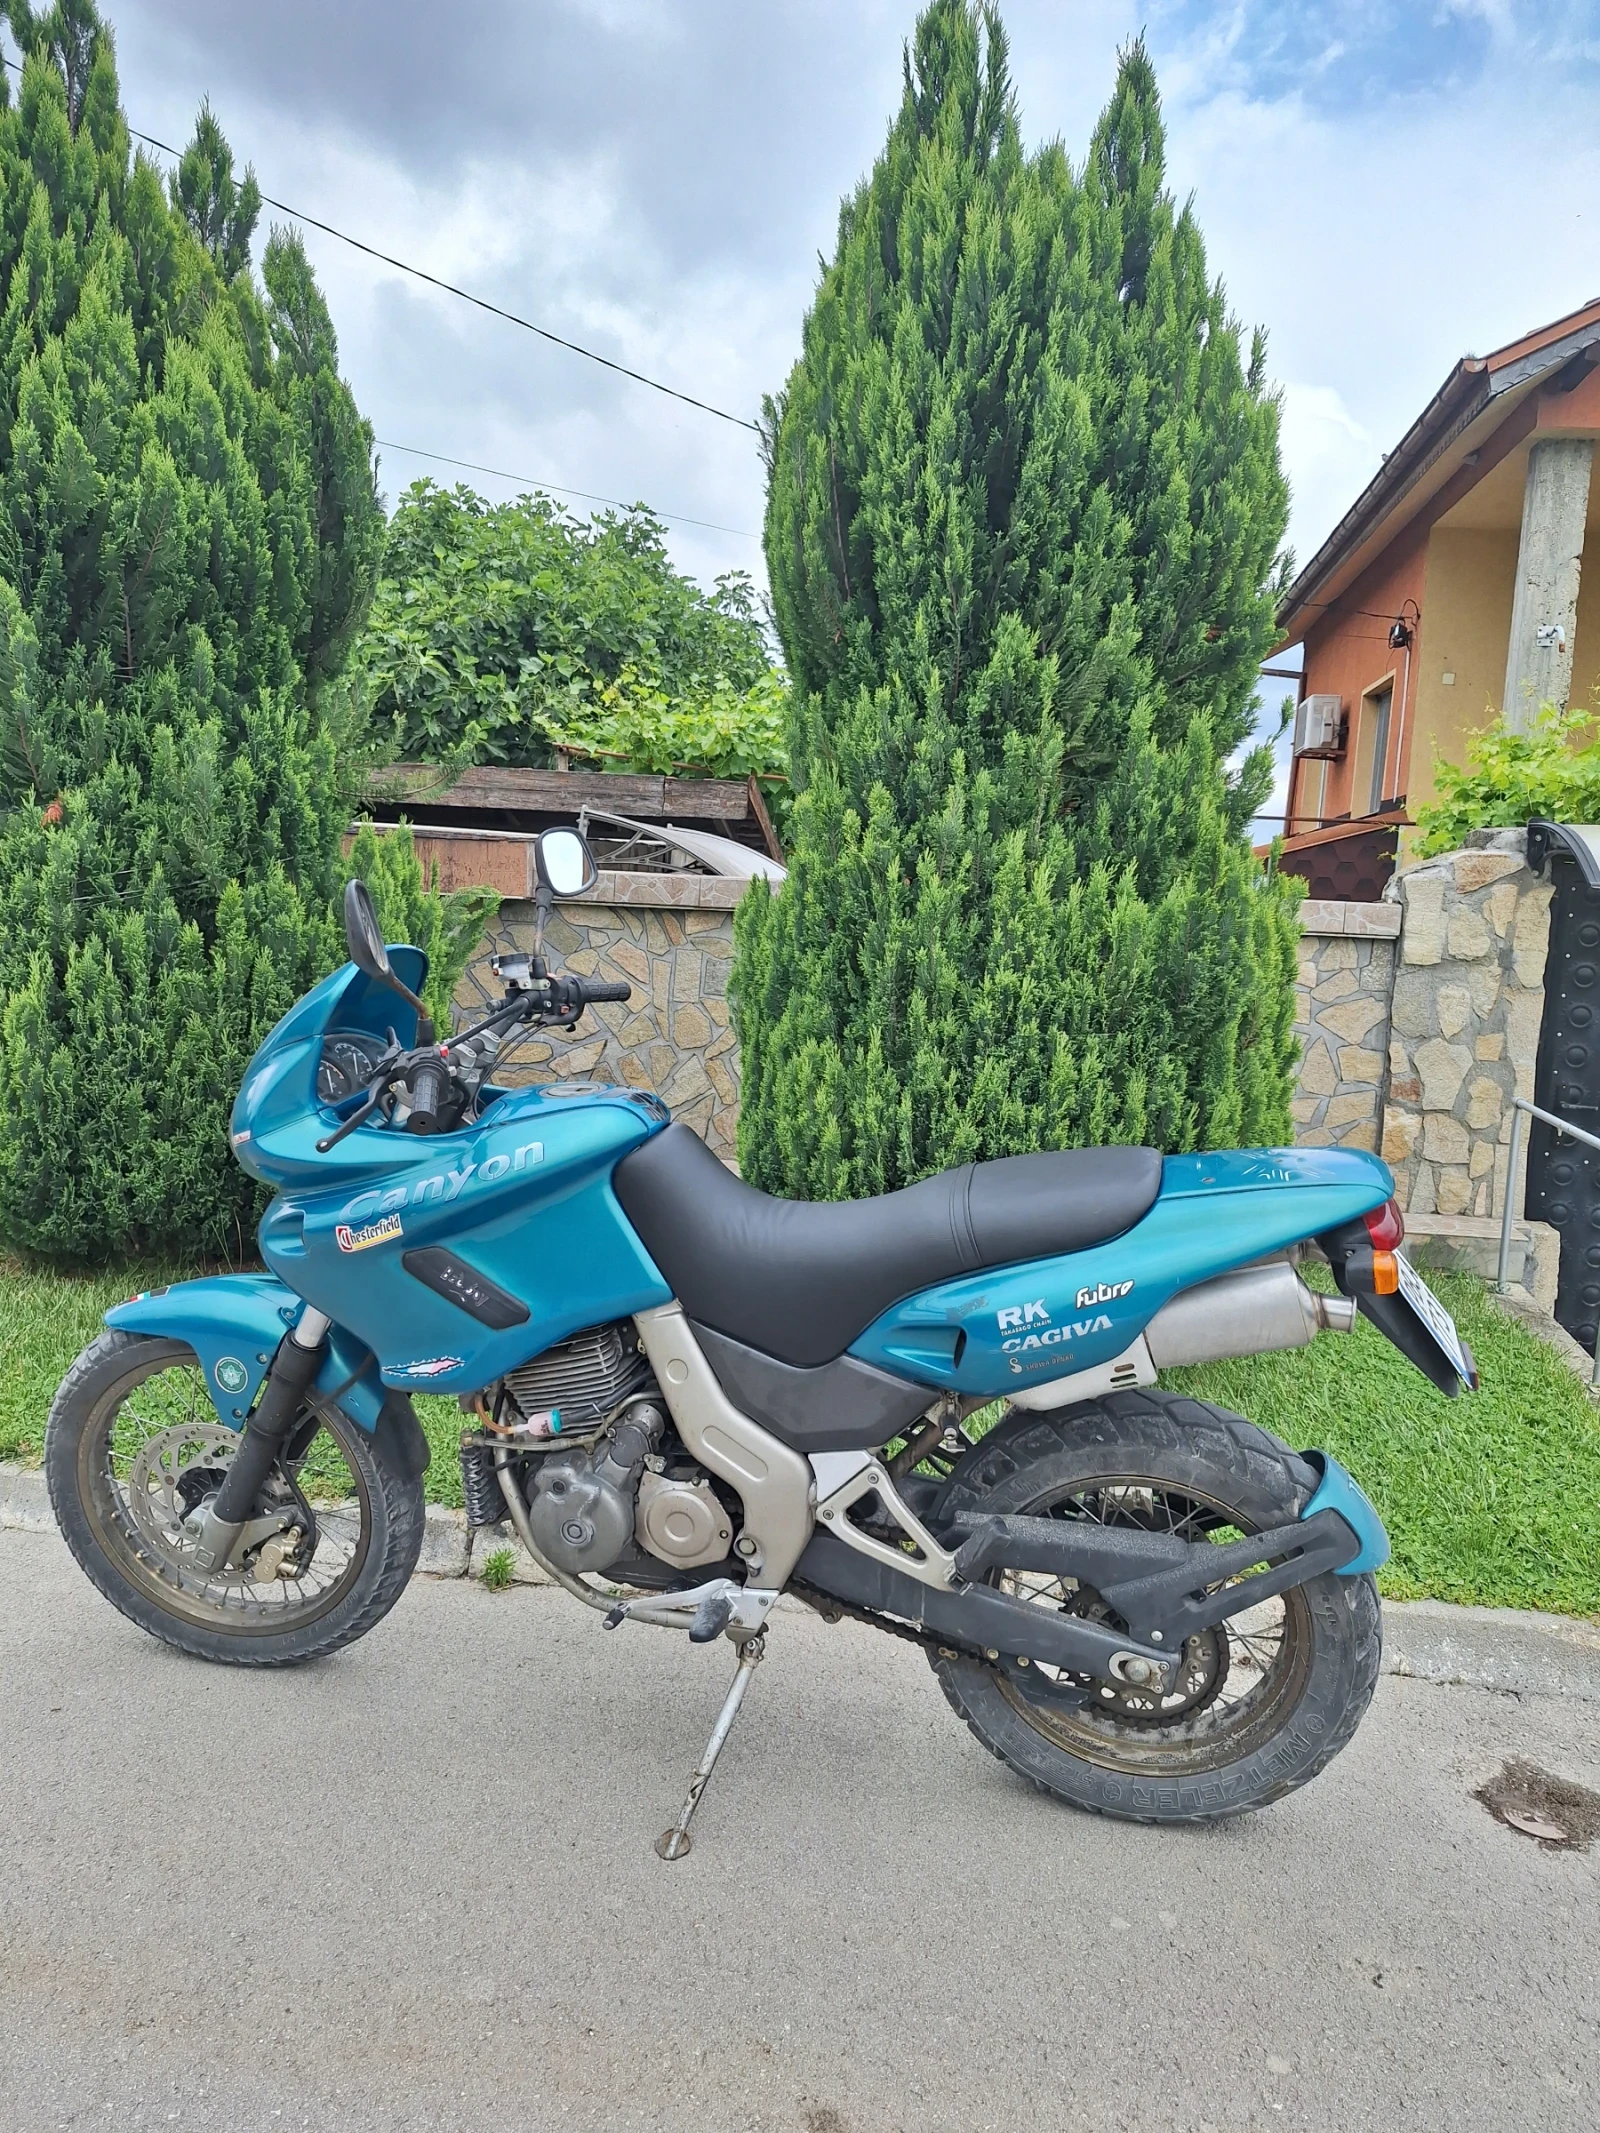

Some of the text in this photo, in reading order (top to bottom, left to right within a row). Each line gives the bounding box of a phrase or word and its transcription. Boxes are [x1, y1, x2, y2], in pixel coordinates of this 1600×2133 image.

[339, 1141, 544, 1225] Canyon
[337, 1215, 400, 1249] Chesterfield
[997, 1299, 1049, 1330] RK
[1001, 1314, 1113, 1353] CAGIVA
[1132, 1732, 1312, 1809] METZELER
